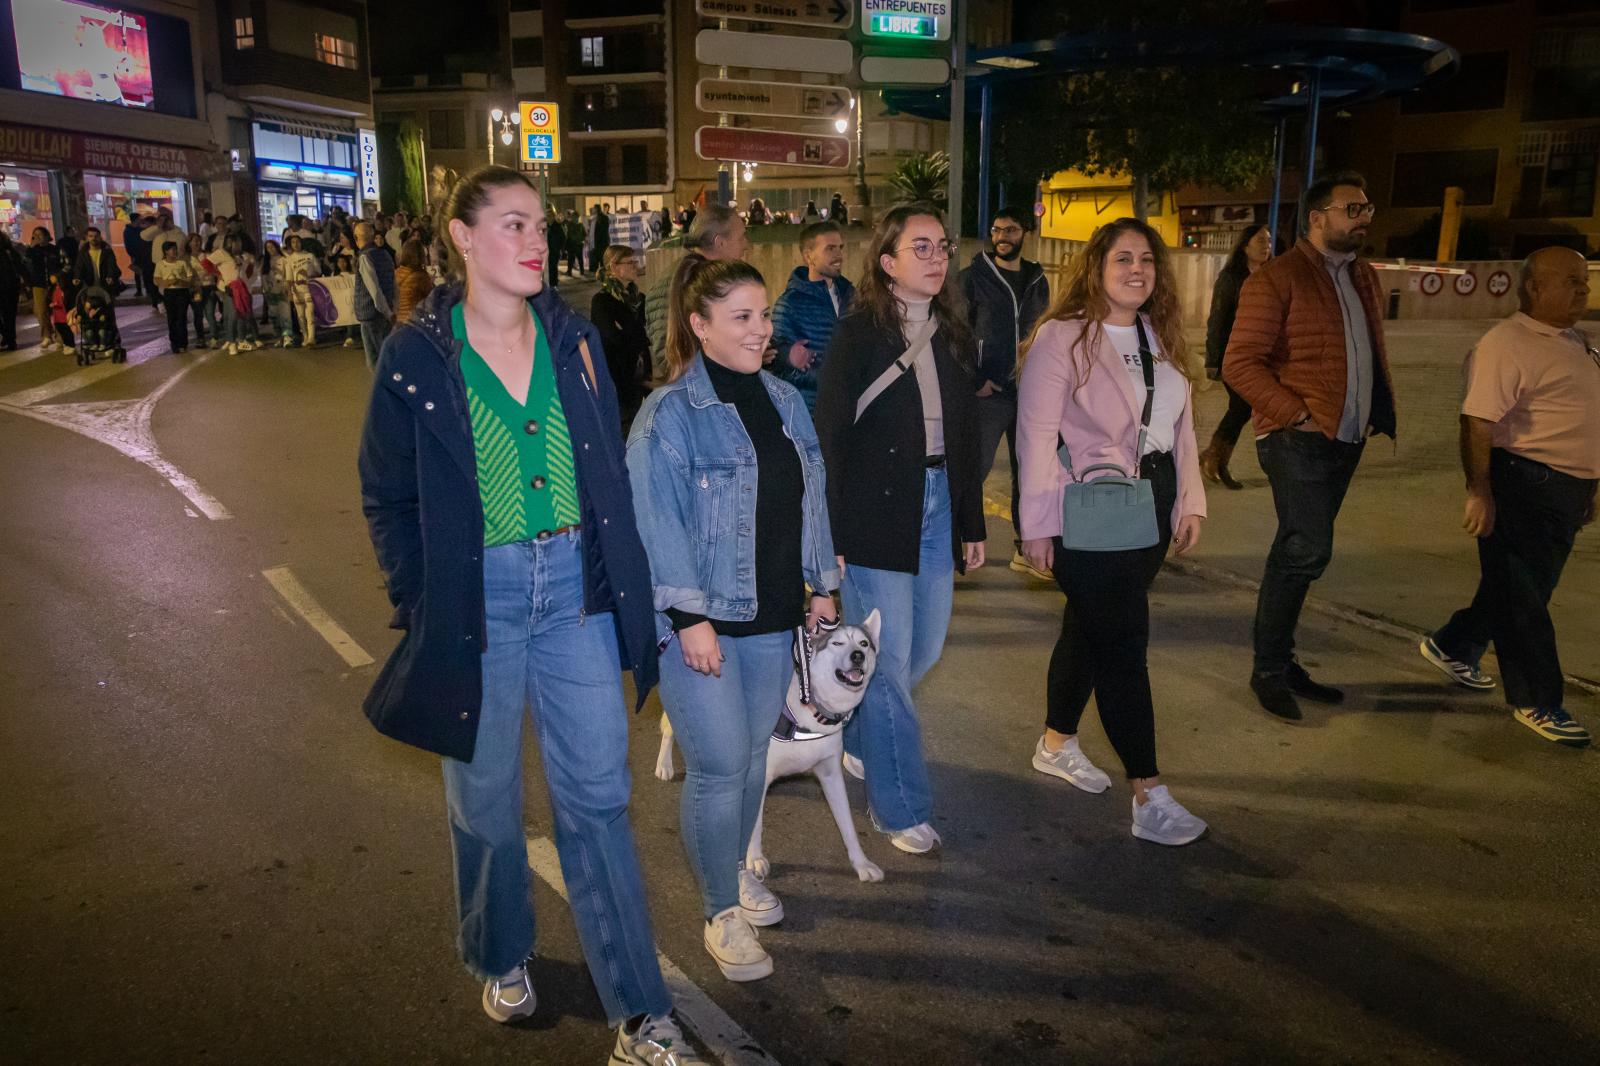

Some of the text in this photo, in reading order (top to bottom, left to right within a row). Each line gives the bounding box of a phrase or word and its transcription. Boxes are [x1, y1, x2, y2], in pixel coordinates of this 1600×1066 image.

[702, 1, 747, 13] campus
[866, 0, 946, 16] ENTREPUENTES
[880, 16, 920, 34] LIBRE
[703, 91, 771, 104] ayuntamiento
[533, 112, 547, 121] 30
[84, 138, 187, 162] SIEMPRE OFERTA
[84, 152, 190, 175] FRUTA Y VERDURA
